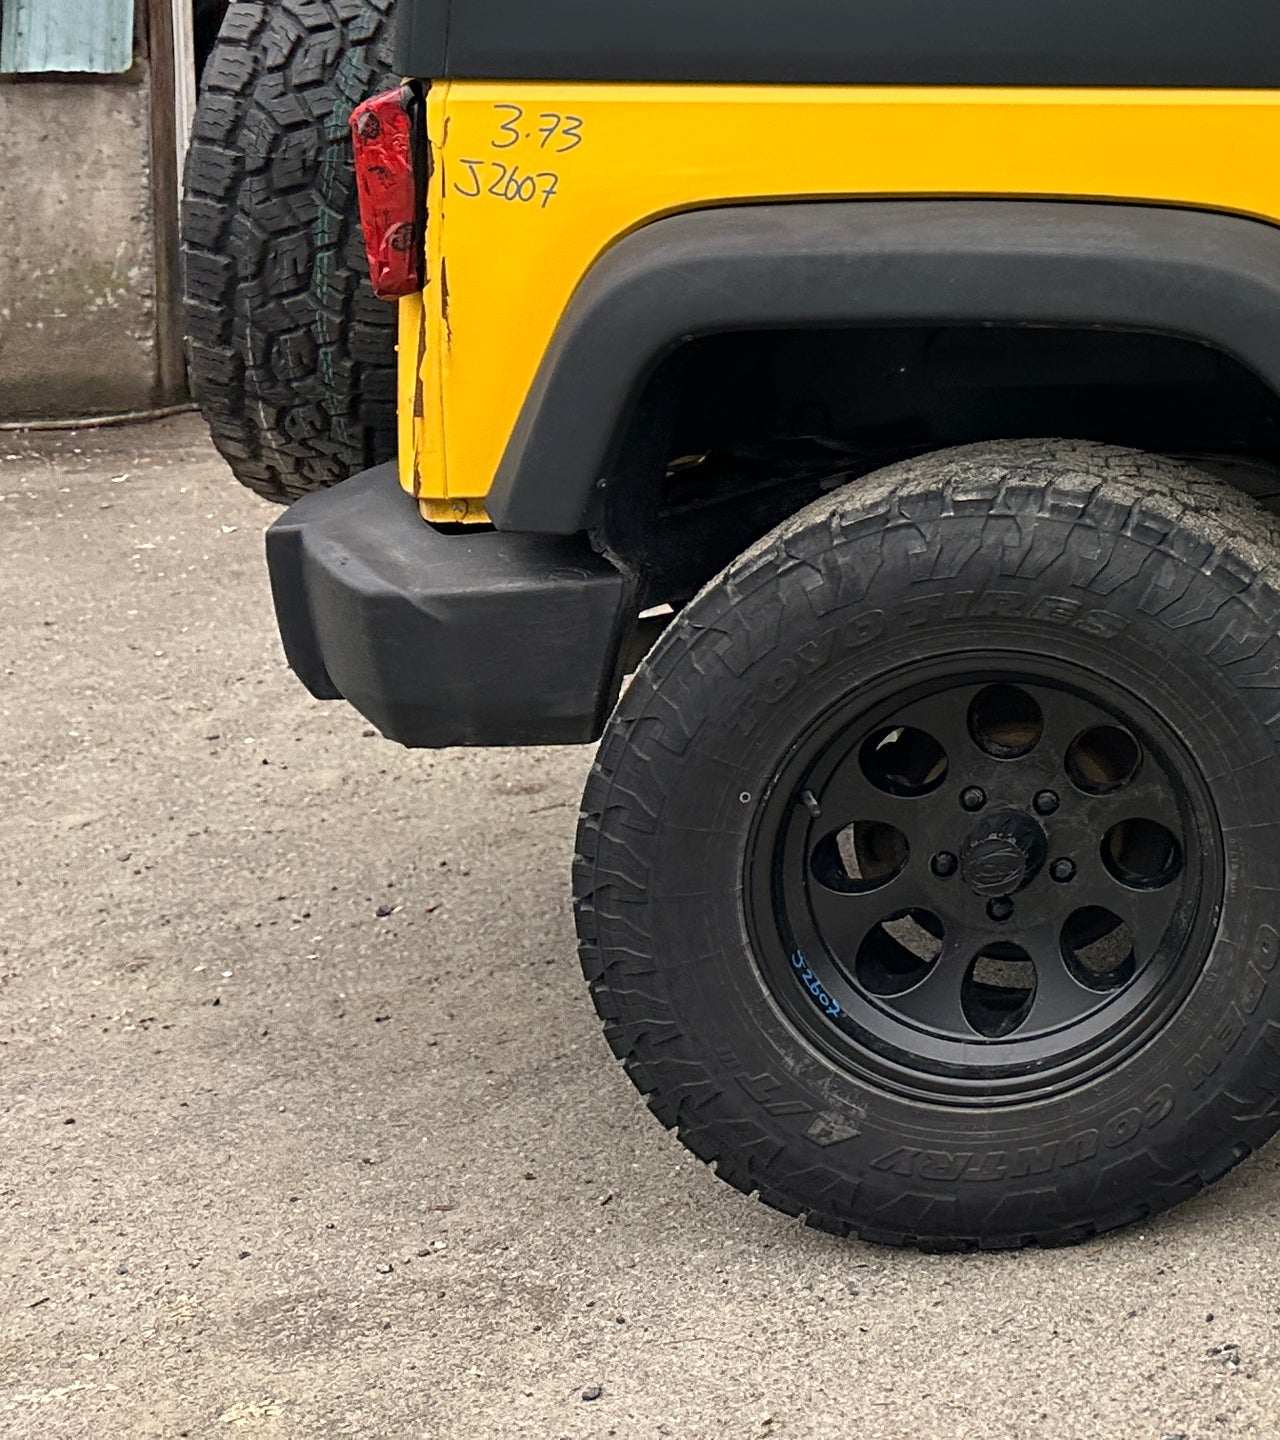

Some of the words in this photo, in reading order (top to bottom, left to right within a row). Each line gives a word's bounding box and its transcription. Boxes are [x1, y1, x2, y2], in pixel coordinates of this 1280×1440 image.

[491, 104, 583, 152] 3.73
[454, 158, 559, 208] J2607
[791, 949, 841, 1018] J2607
